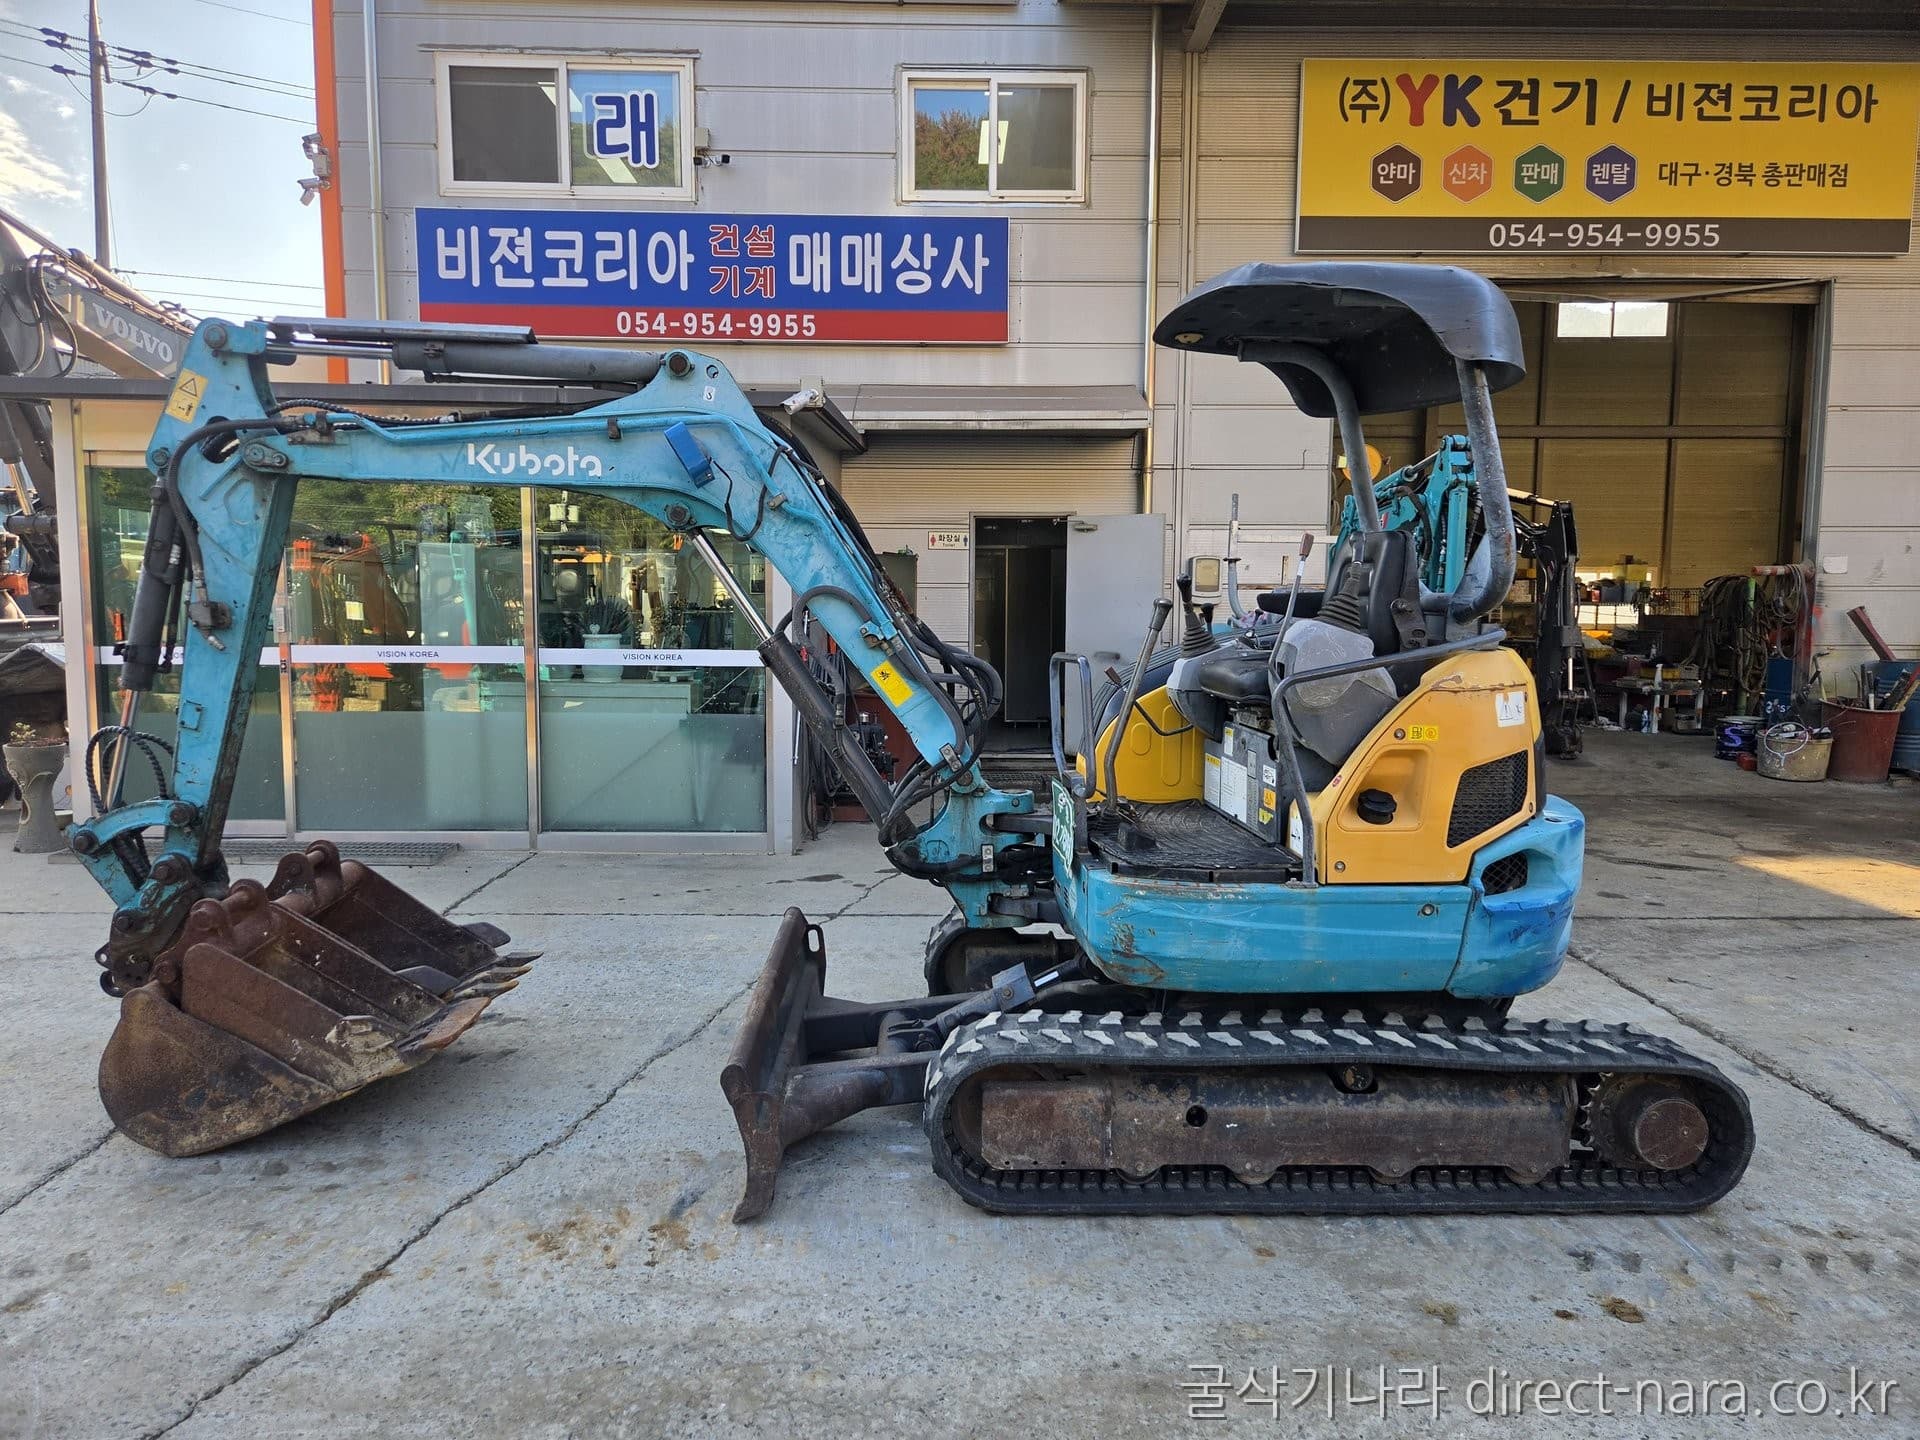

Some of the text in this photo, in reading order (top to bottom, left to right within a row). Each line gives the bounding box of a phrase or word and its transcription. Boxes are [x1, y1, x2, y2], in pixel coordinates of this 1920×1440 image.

[1646, 82, 1879, 123] 비젼코리아
[592, 89, 659, 168] 래
[1377, 163, 1416, 185] 얀마
[1449, 163, 1487, 186] 신차
[1521, 163, 1560, 185] 판매
[1592, 163, 1631, 185] 렌탈
[1761, 162, 1849, 188] 총판매점
[1489, 223, 1720, 248] 054-954-9955
[436, 223, 990, 299] 비젼코리아 건설 기계 매매상사
[92, 302, 173, 363] VOLVO
[616, 311, 817, 337] 054-954-9955
[468, 443, 602, 477] Kubota
